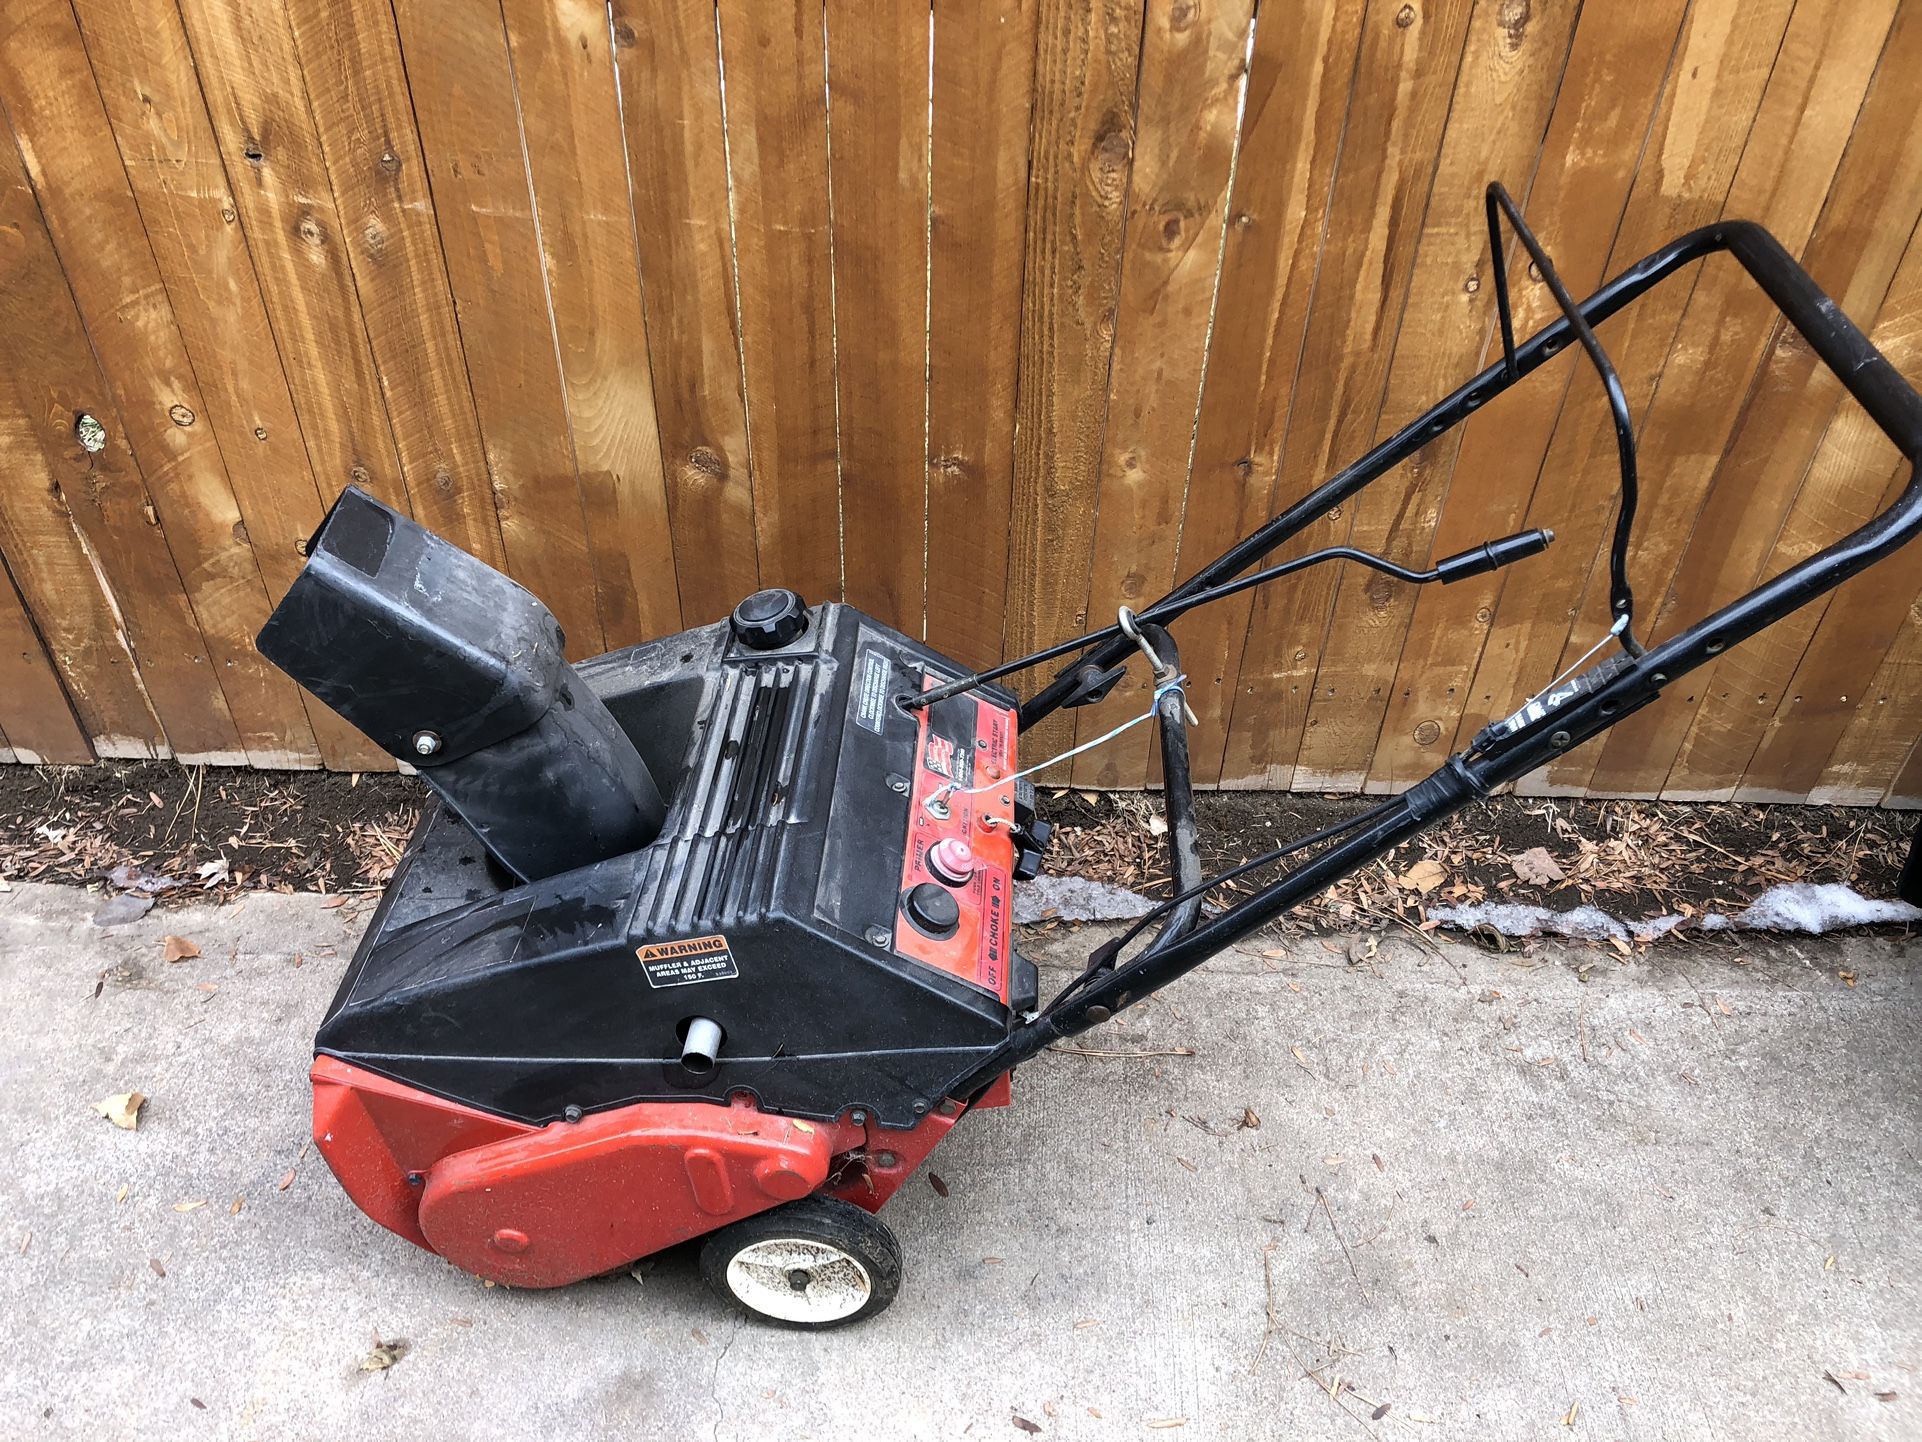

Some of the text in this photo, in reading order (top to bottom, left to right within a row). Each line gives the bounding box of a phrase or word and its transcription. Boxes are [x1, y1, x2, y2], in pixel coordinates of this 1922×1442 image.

[864, 674, 872, 694] DIRECTION
[872, 672, 880, 694] DISCHARGE
[862, 691, 870, 706] CHUTE
[868, 697, 877, 719] CLOCKWISE
[860, 704, 868, 718] CRANK
[914, 839, 924, 872] PRIMER
[988, 876, 1000, 985] OFF CHOKE ON
[656, 939, 723, 957] WARNING
[648, 961, 682, 972] MUFFLER
[690, 955, 728, 967] ADJACENT
[656, 962, 727, 978] AREAS MAY EXCEED
